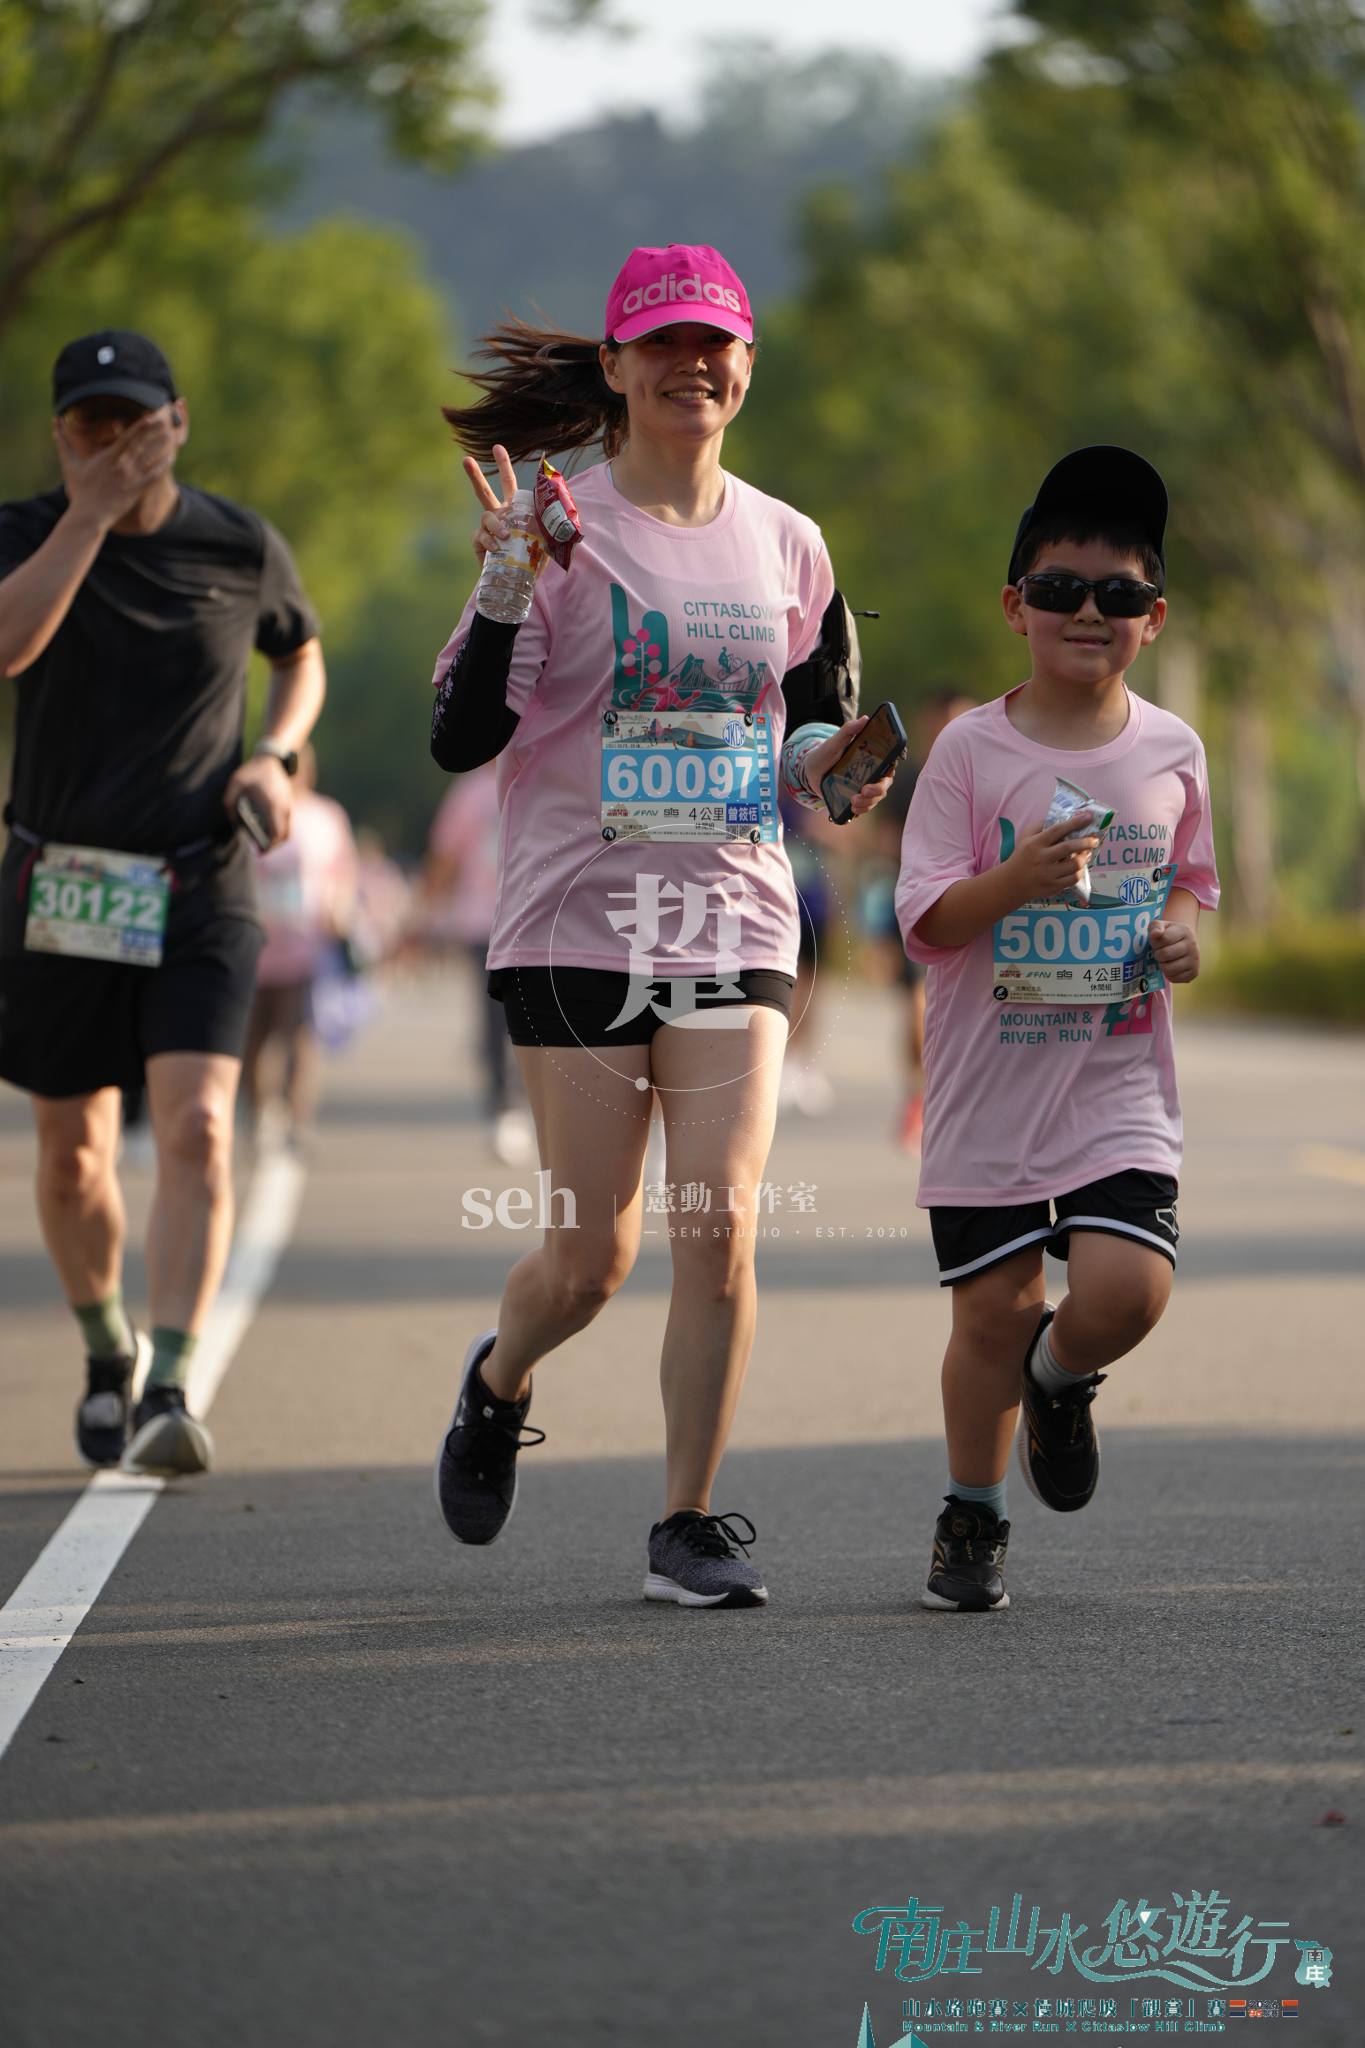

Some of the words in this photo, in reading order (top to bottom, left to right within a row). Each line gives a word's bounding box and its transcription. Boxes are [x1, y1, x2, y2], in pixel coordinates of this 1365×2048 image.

[623, 273, 741, 314] adidas
[683, 602, 773, 620] CITTASLOW
[686, 622, 724, 639] HILL
[729, 624, 776, 643] CLIMB
[608, 754, 752, 799] 60097
[1108, 824, 1168, 841] TASLOW
[1122, 847, 1166, 864] CLIMB
[32, 880, 162, 930] 30122
[1000, 1012, 1077, 1026] MOUNTAIN
[1081, 1010, 1093, 1024] &
[1000, 1031, 1047, 1044] RIVER
[1059, 1029, 1092, 1042] RUN
